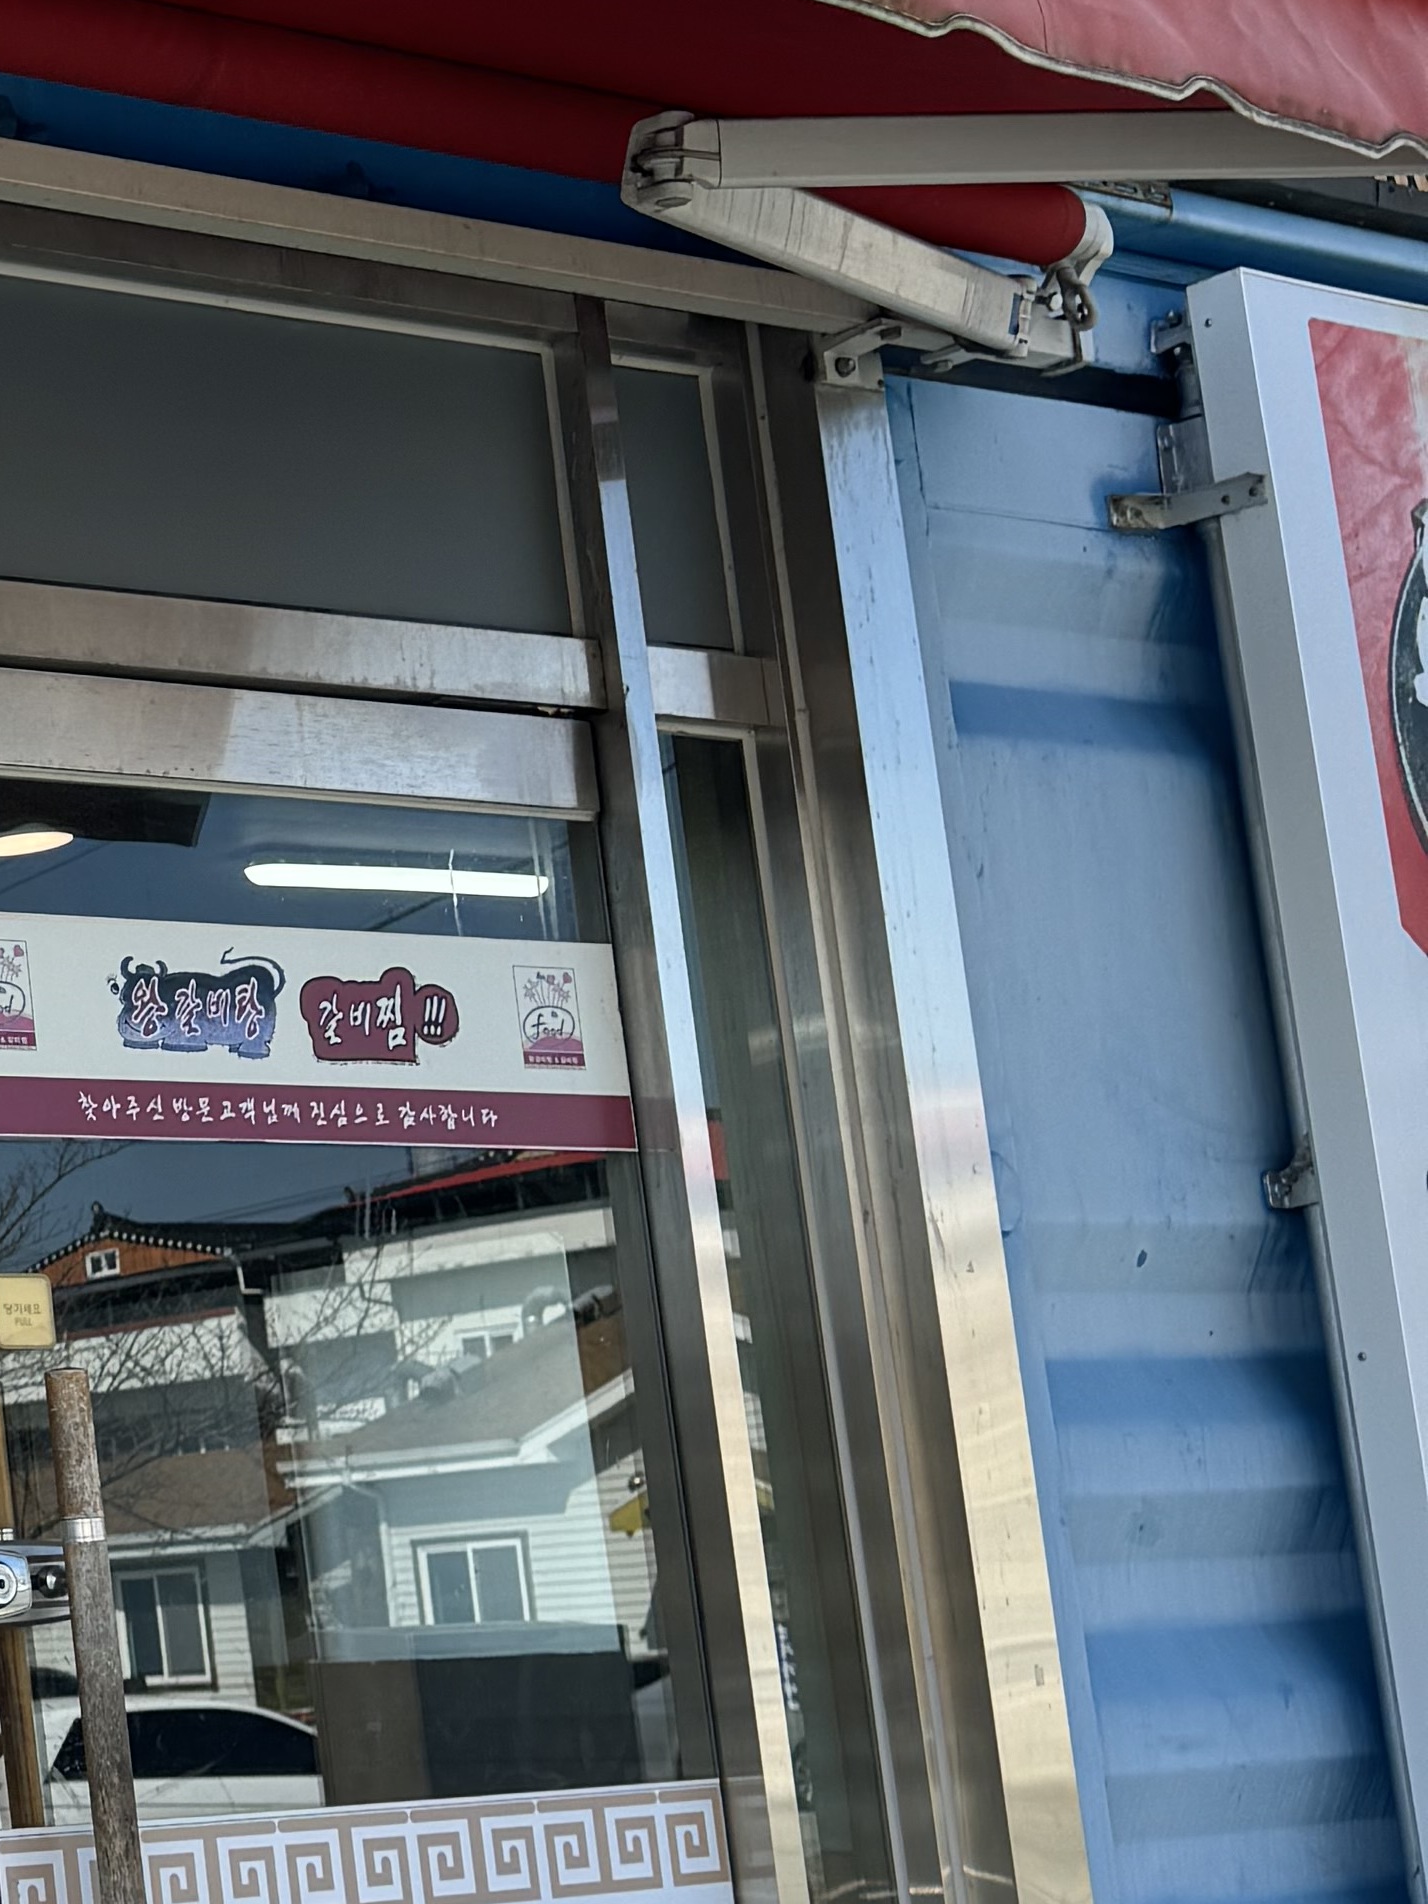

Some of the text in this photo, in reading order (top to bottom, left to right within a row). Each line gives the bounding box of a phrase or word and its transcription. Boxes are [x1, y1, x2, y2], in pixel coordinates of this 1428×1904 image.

[78, 1091, 164, 1121] 찾아주신
[310, 1101, 390, 1127] 진심으로
[398, 1103, 498, 1130] 감사합니다
[3, 1303, 41, 1315] 당기세요
[14, 1317, 33, 1326] PULL
